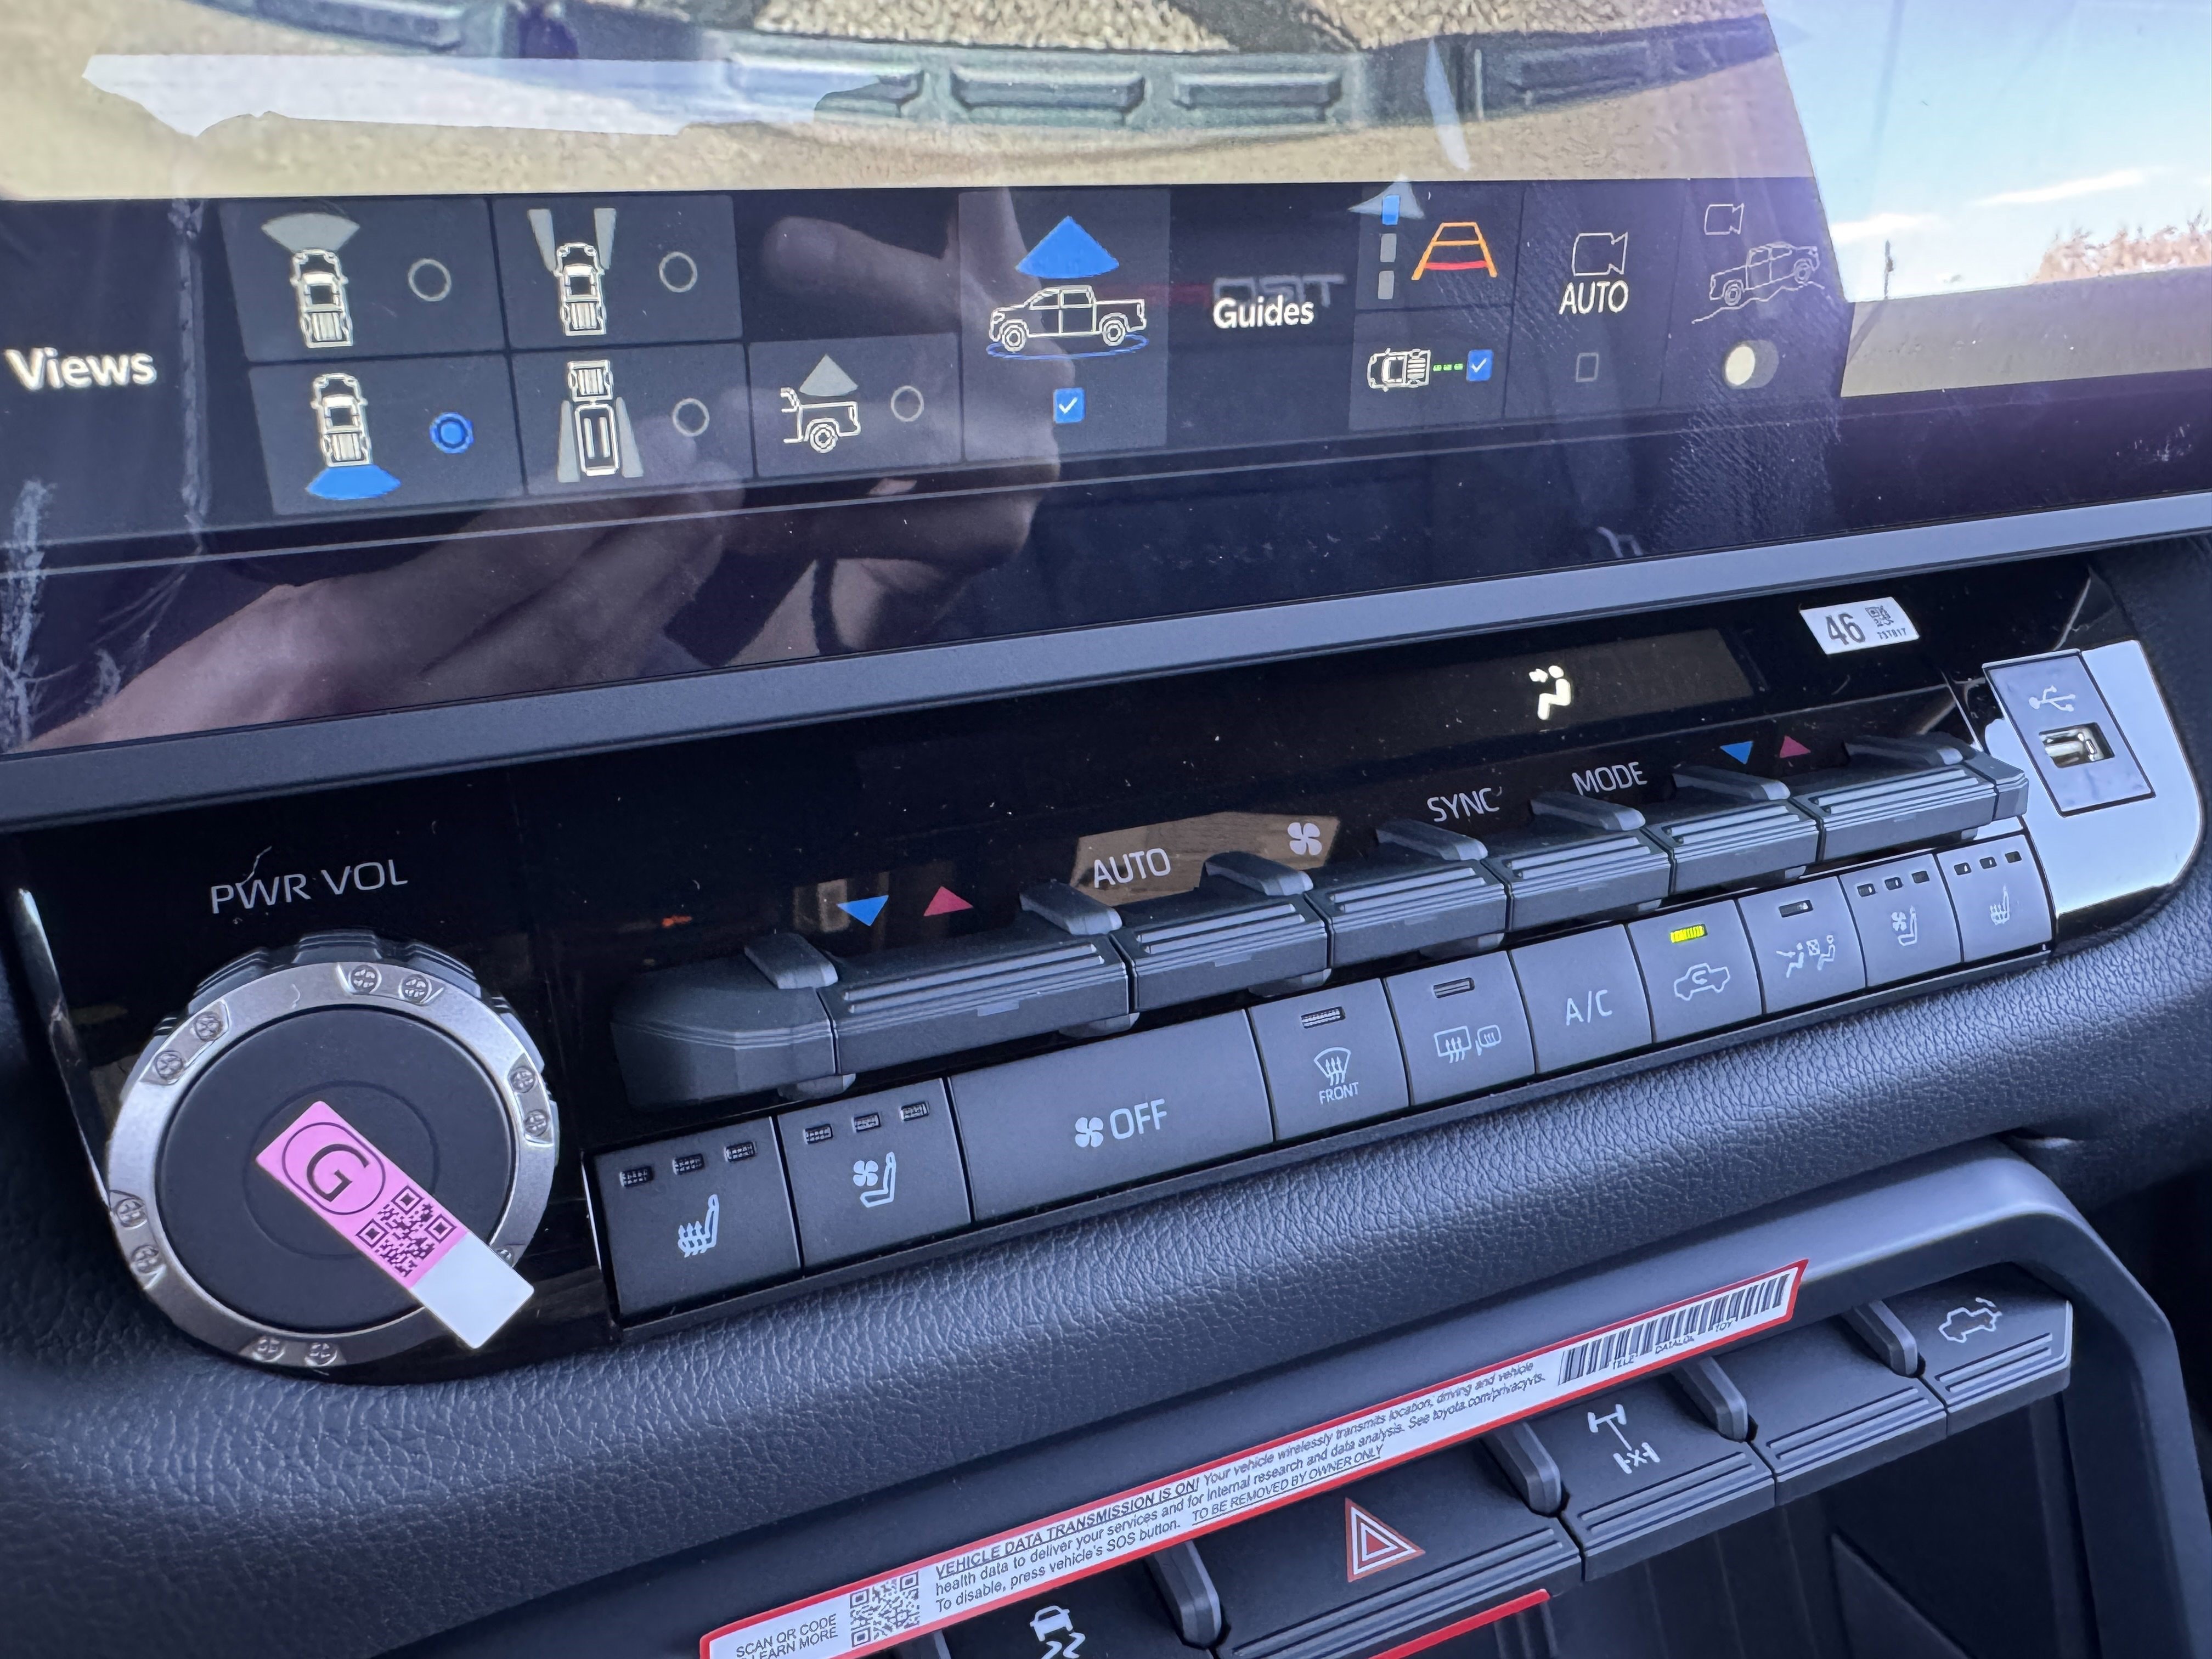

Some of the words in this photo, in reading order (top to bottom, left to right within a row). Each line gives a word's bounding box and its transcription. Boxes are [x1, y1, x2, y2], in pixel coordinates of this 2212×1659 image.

[1213, 295, 1314, 328] Guides
[1559, 280, 1629, 314] AUTO
[5, 347, 157, 390] Views
[1825, 613, 1866, 645] 46
[1572, 762, 1647, 795] MODE
[1427, 788, 1499, 822] SYNC
[211, 873, 312, 914] PWR
[321, 859, 408, 895] VOL
[1094, 848, 1171, 888] AUTO
[1566, 989, 1612, 1026] A/C
[1318, 1082, 1359, 1104] FRONT
[1109, 1098, 1167, 1139] OFF
[307, 1143, 369, 1202] G
[936, 1545, 1002, 1577] VEHICLE
[1004, 1532, 1044, 1556] DATA
[1047, 1492, 1156, 1541] TRANSMISSION
[1158, 1488, 1173, 1503] IS
[1175, 1477, 1199, 1497] ON!
[1204, 1469, 1231, 1486] Your
[1234, 1454, 1274, 1476] vehicle
[1278, 1433, 1333, 1460] wirelessly
[1336, 1415, 1386, 1440] transmits
[1389, 1399, 1434, 1421] location,
[1437, 1384, 1472, 1403] driving
[1475, 1373, 1496, 1390] and
[1498, 1362, 1533, 1381] vehicle
[1192, 1508, 1208, 1521] TO
[1212, 1500, 1227, 1515] BE
[1231, 1479, 1289, 1508] REMOVED
[1291, 1471, 1307, 1486] BY
[1309, 1456, 1355, 1479] OWNER
[1354, 1443, 1384, 1463] ONLY
[936, 1572, 975, 1596] health
[980, 1562, 1008, 1580] data
[1014, 1557, 1025, 1569] to
[1030, 1540, 1073, 1562] deliver
[1076, 1529, 1104, 1550] your
[1107, 1510, 1158, 1536] services
[1161, 1498, 1183, 1517] and
[1188, 1494, 1204, 1508] for
[1254, 1459, 1303, 1485] research
[1307, 1448, 1327, 1466] and
[1331, 1440, 1355, 1457] data
[1358, 1423, 1405, 1447] analysis.
[1408, 1414, 1430, 1429] See
[936, 1598, 951, 1612] To
[956, 1581, 1006, 1605] disable,
[1011, 1566, 1045, 1590] press
[1049, 1545, 1102, 1572] vehicle's
[1107, 1532, 1135, 1551] SOS
[1140, 1520, 1180, 1541] button.
[736, 1635, 772, 1658] SCAN
[776, 1628, 797, 1644] QR
[799, 1613, 837, 1635] CODE
[799, 1626, 838, 1650] MORE
